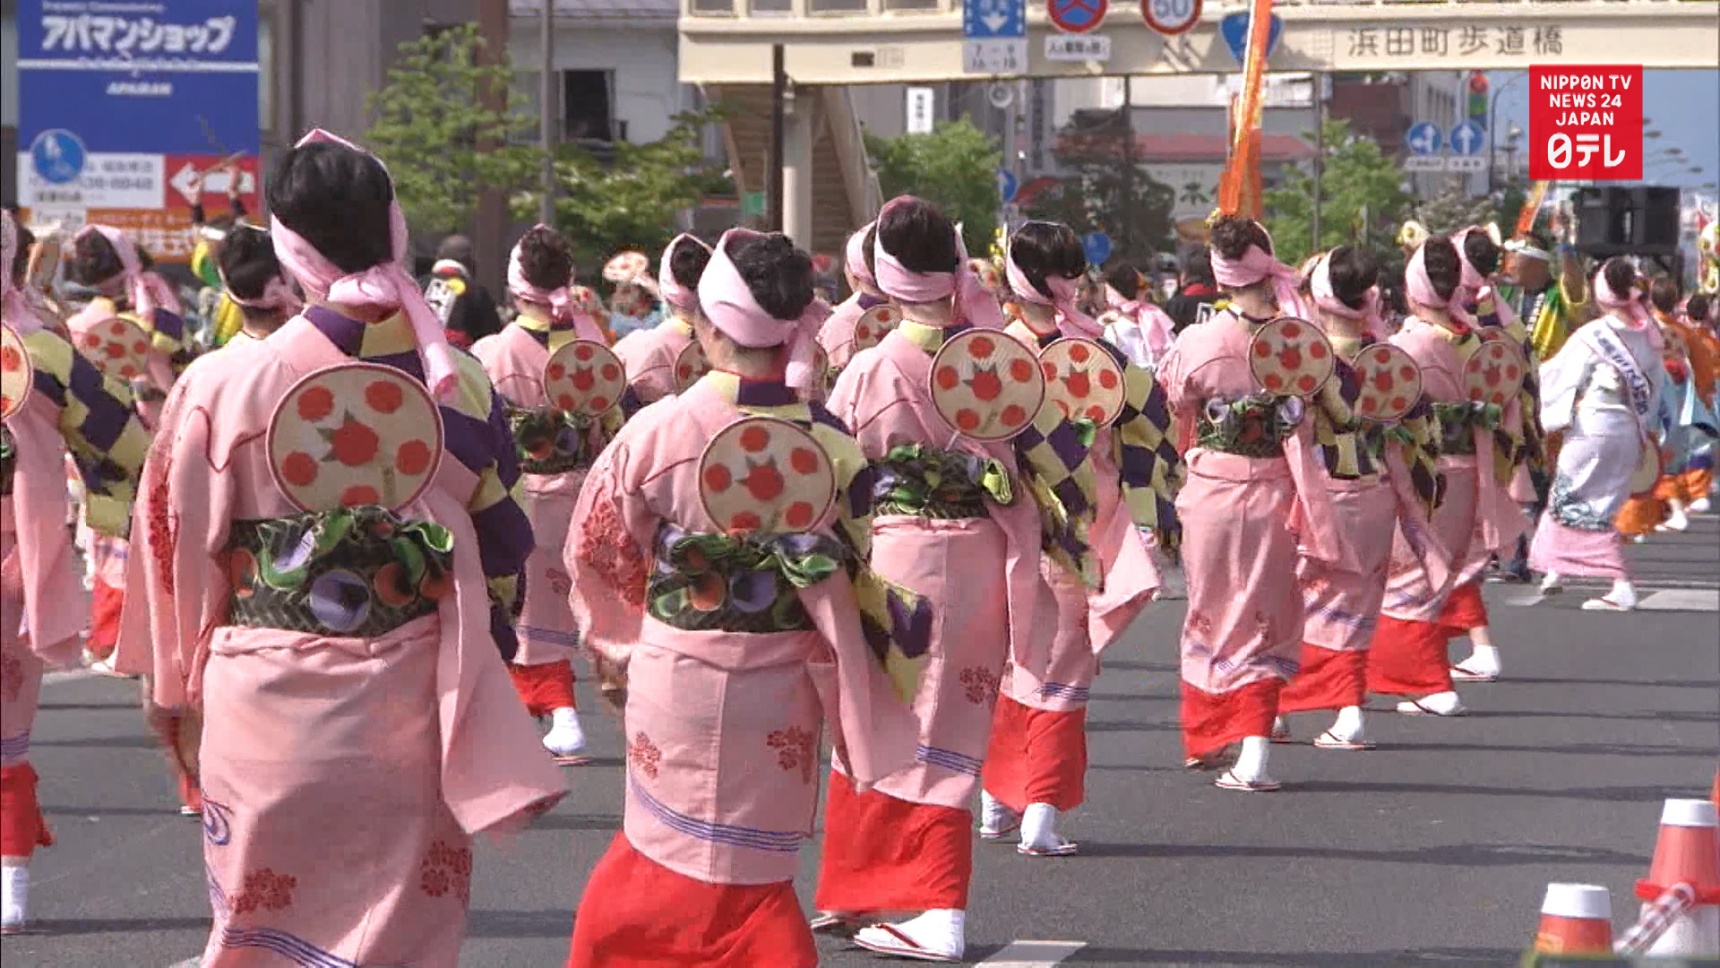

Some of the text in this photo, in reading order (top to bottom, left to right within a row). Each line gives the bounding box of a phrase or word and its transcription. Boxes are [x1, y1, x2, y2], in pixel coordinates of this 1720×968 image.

[41, 14, 236, 54] アパマンショップ
[1347, 25, 1563, 57] 浜田町歩道橋
